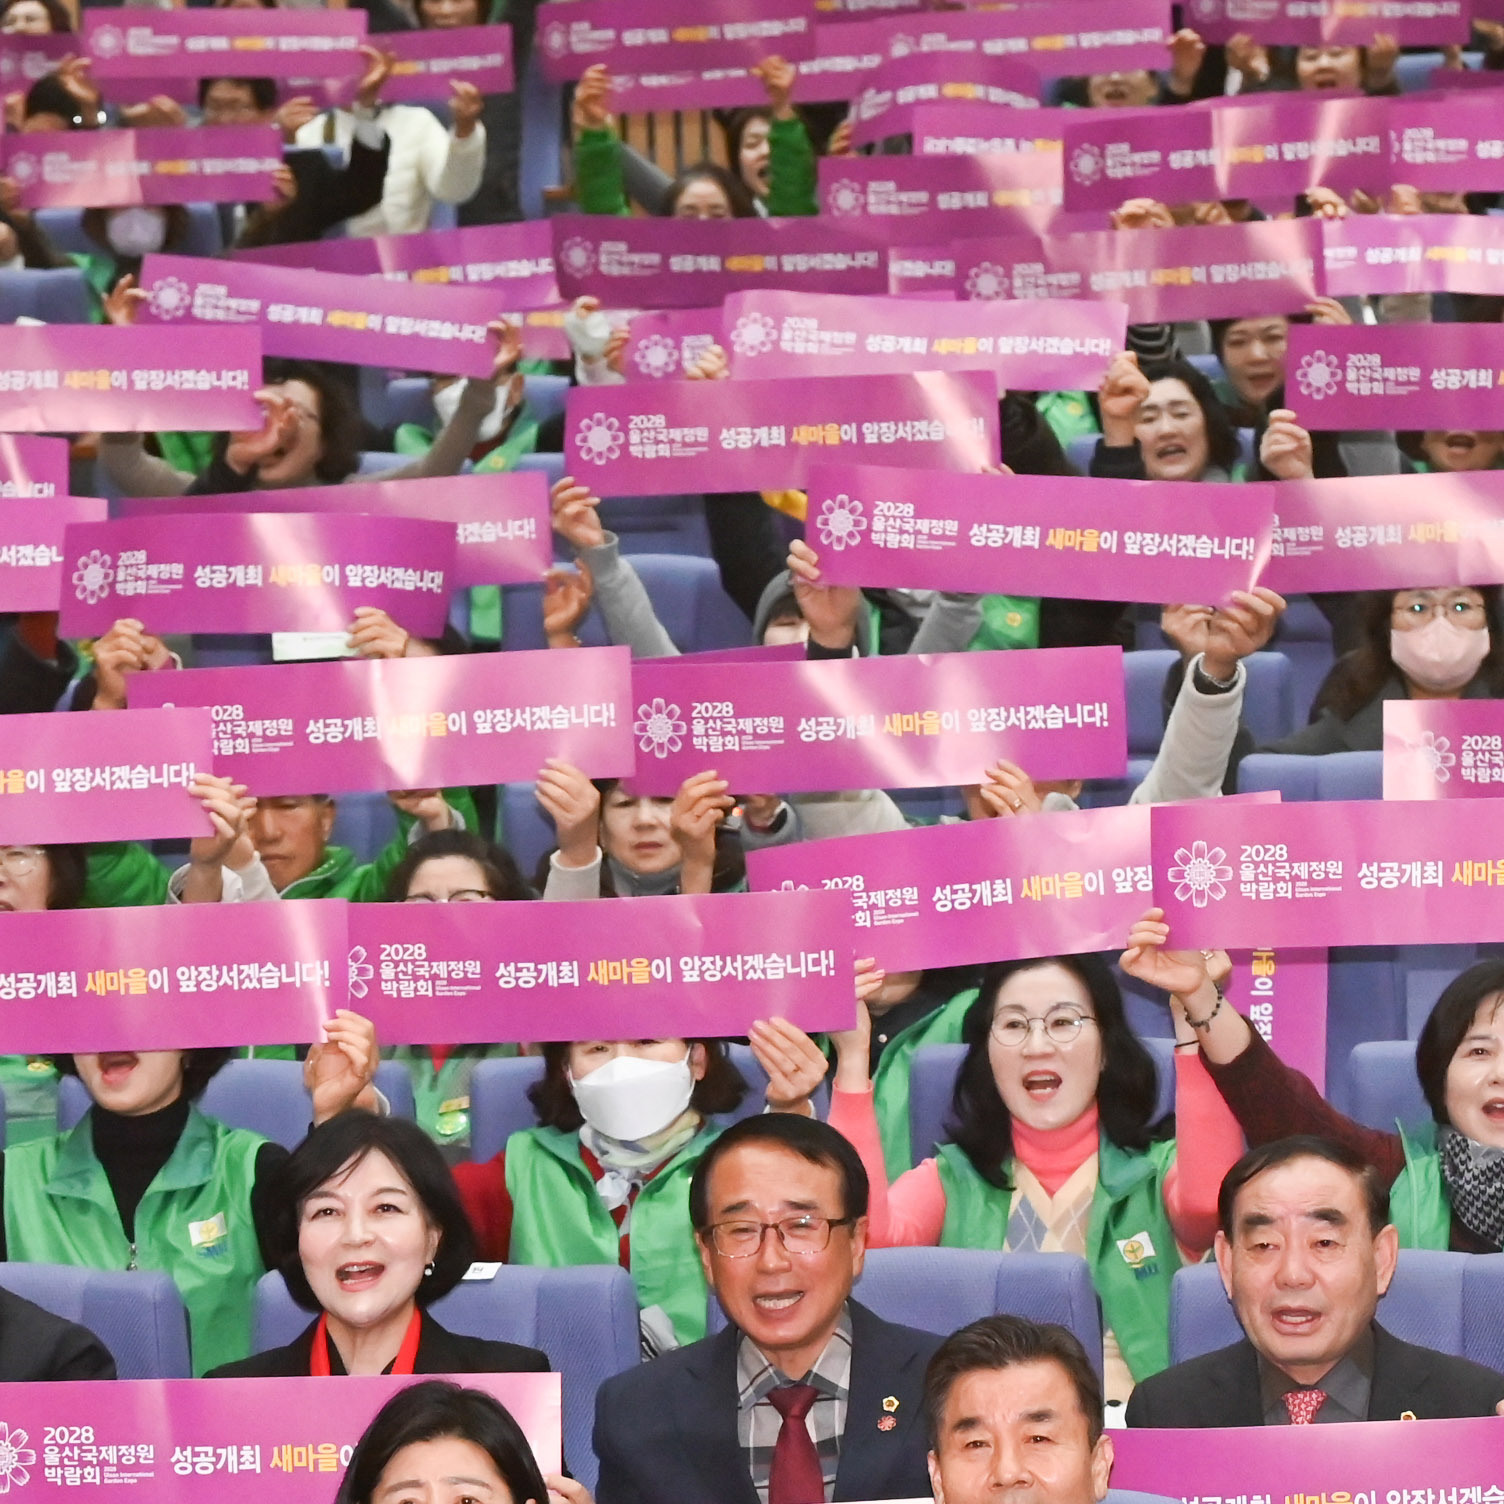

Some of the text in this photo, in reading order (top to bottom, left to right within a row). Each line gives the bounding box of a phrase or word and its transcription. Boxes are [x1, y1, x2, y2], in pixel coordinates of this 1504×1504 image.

[968, 523, 1254, 559] 성공개최 새마을이 앞장서겠습니다!
[52, 762, 195, 792] 앞장서겠습니다!
[1240, 843, 1288, 861] 2028
[1240, 861, 1343, 881] 울산국제정원
[1357, 860, 1443, 889] 성공개최
[1240, 881, 1292, 900] 박람회
[380, 943, 426, 961] 2028
[84, 966, 169, 996] 새마을이
[176, 959, 329, 992] 앞장서겠습니다!
[380, 960, 481, 980] 울산국제정원
[495, 950, 835, 989] 성공개최 새마을이 앞장서겠습니다!
[382, 980, 433, 999] 박람회
[44, 1425, 94, 1445] 2028
[44, 1444, 154, 1466] 울산국제정원
[170, 1444, 261, 1475] 성공개최
[45, 1466, 101, 1486] 박람회
